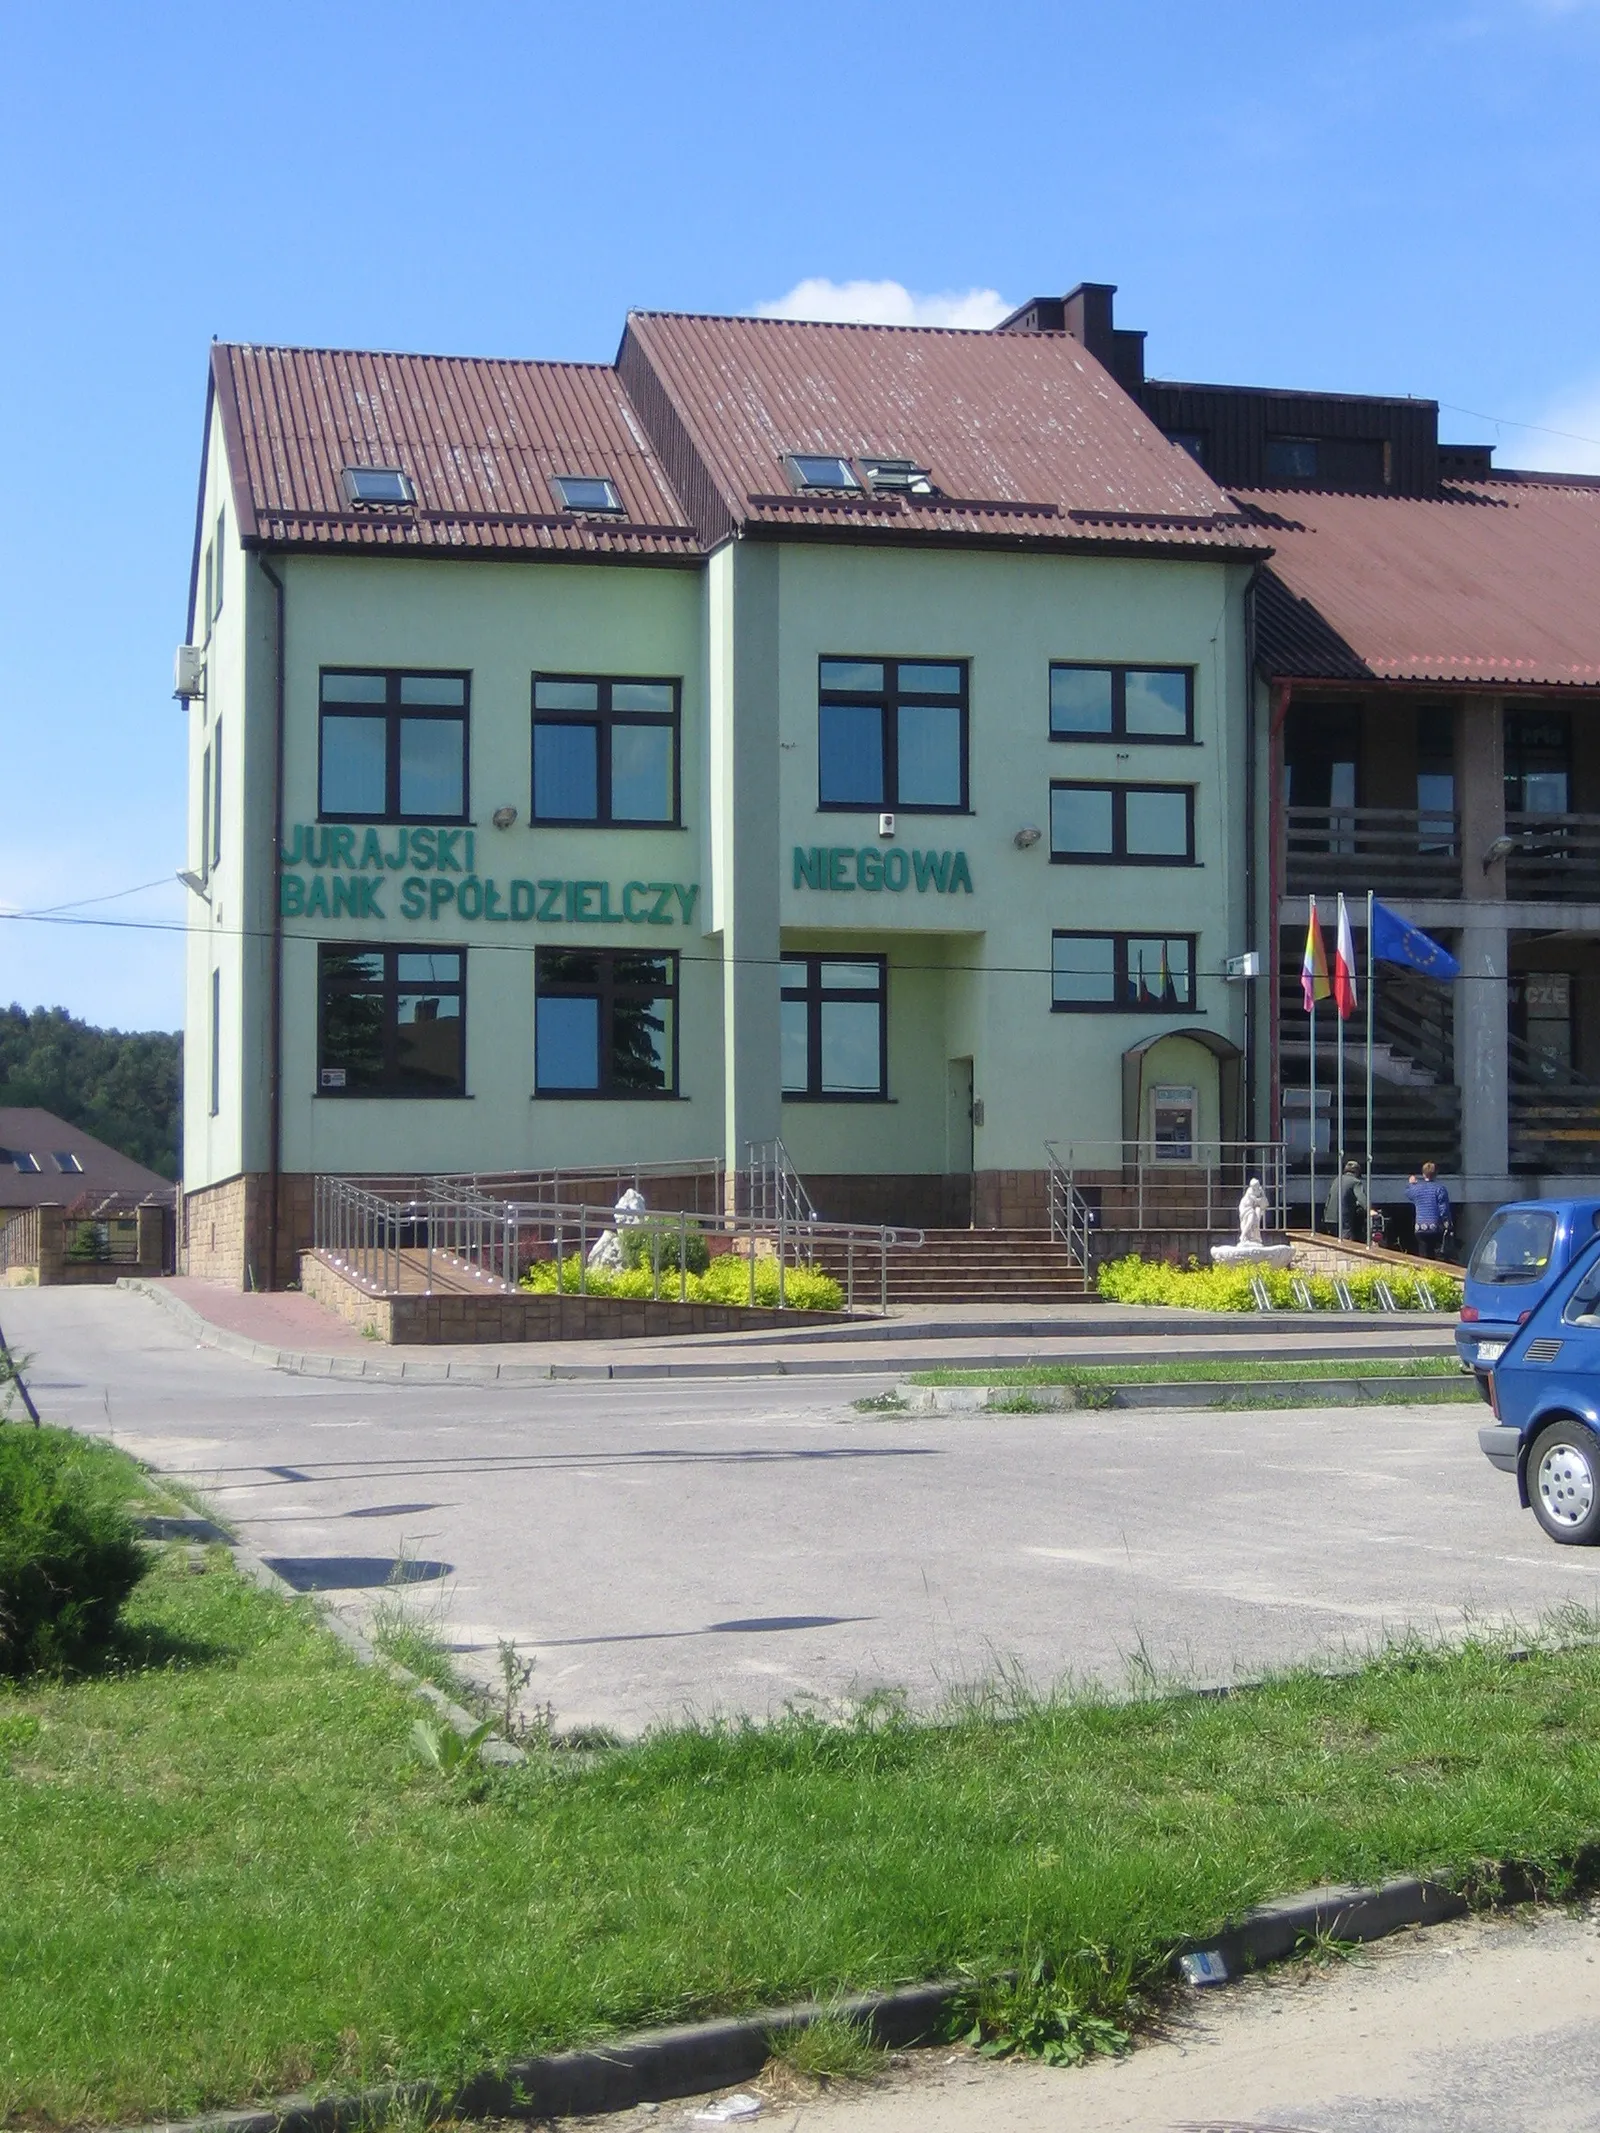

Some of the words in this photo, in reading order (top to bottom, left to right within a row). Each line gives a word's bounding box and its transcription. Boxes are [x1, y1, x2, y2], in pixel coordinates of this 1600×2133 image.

[281, 824, 476, 872] JURAJSKI
[793, 846, 974, 893] NIEGOWA
[281, 874, 386, 919] BANK
[400, 874, 699, 925] SPÓŁDZIELCZY
